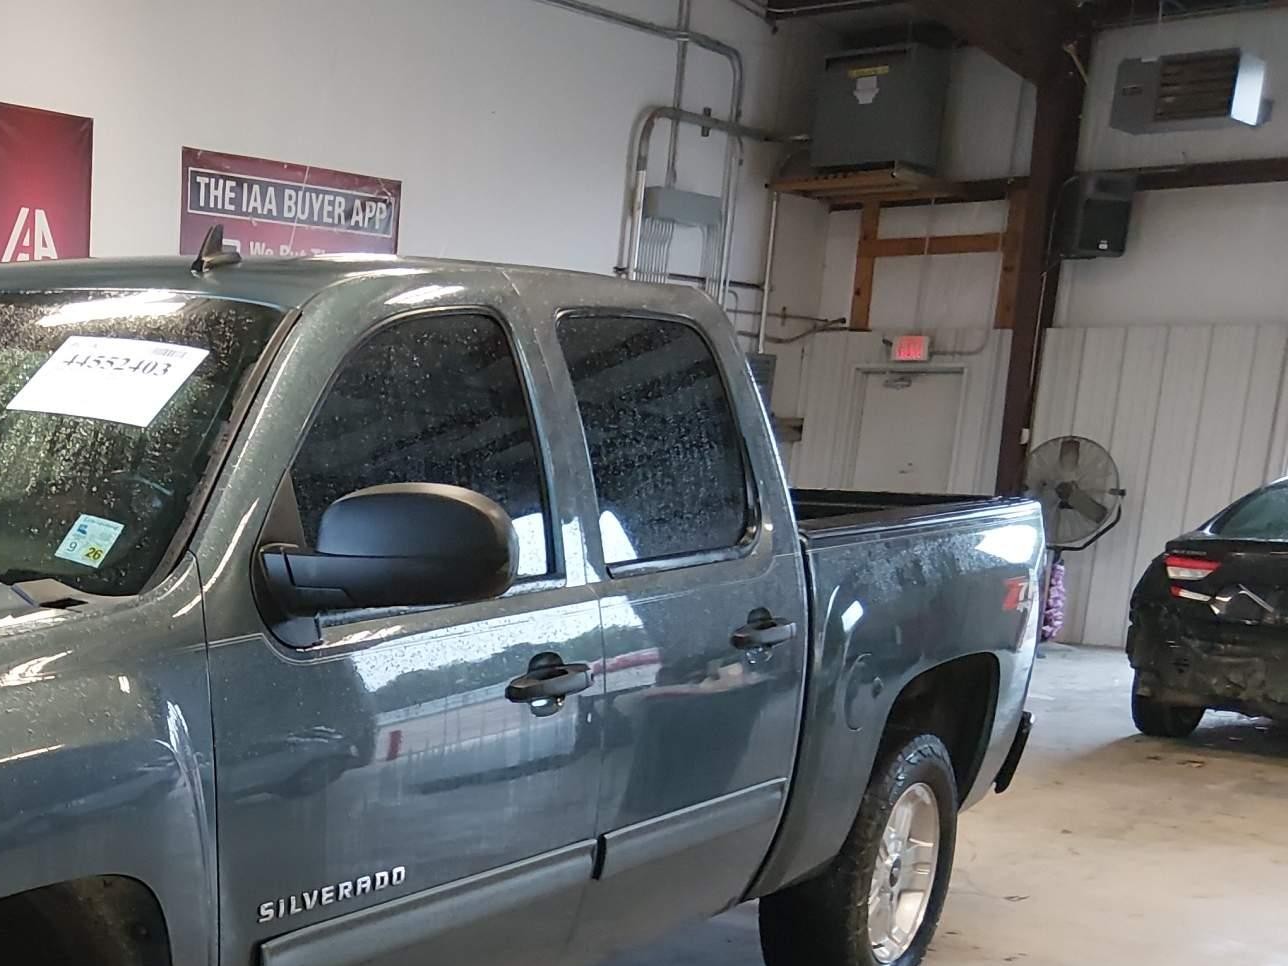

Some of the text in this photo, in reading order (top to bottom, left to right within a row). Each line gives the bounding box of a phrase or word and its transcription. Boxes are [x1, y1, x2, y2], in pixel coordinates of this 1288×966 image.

[196, 176, 388, 229] THE IAA BUYER APP
[63, 353, 172, 375] 44552403
[85, 547, 103, 560] 26
[258, 865, 406, 924] SILVERADO
